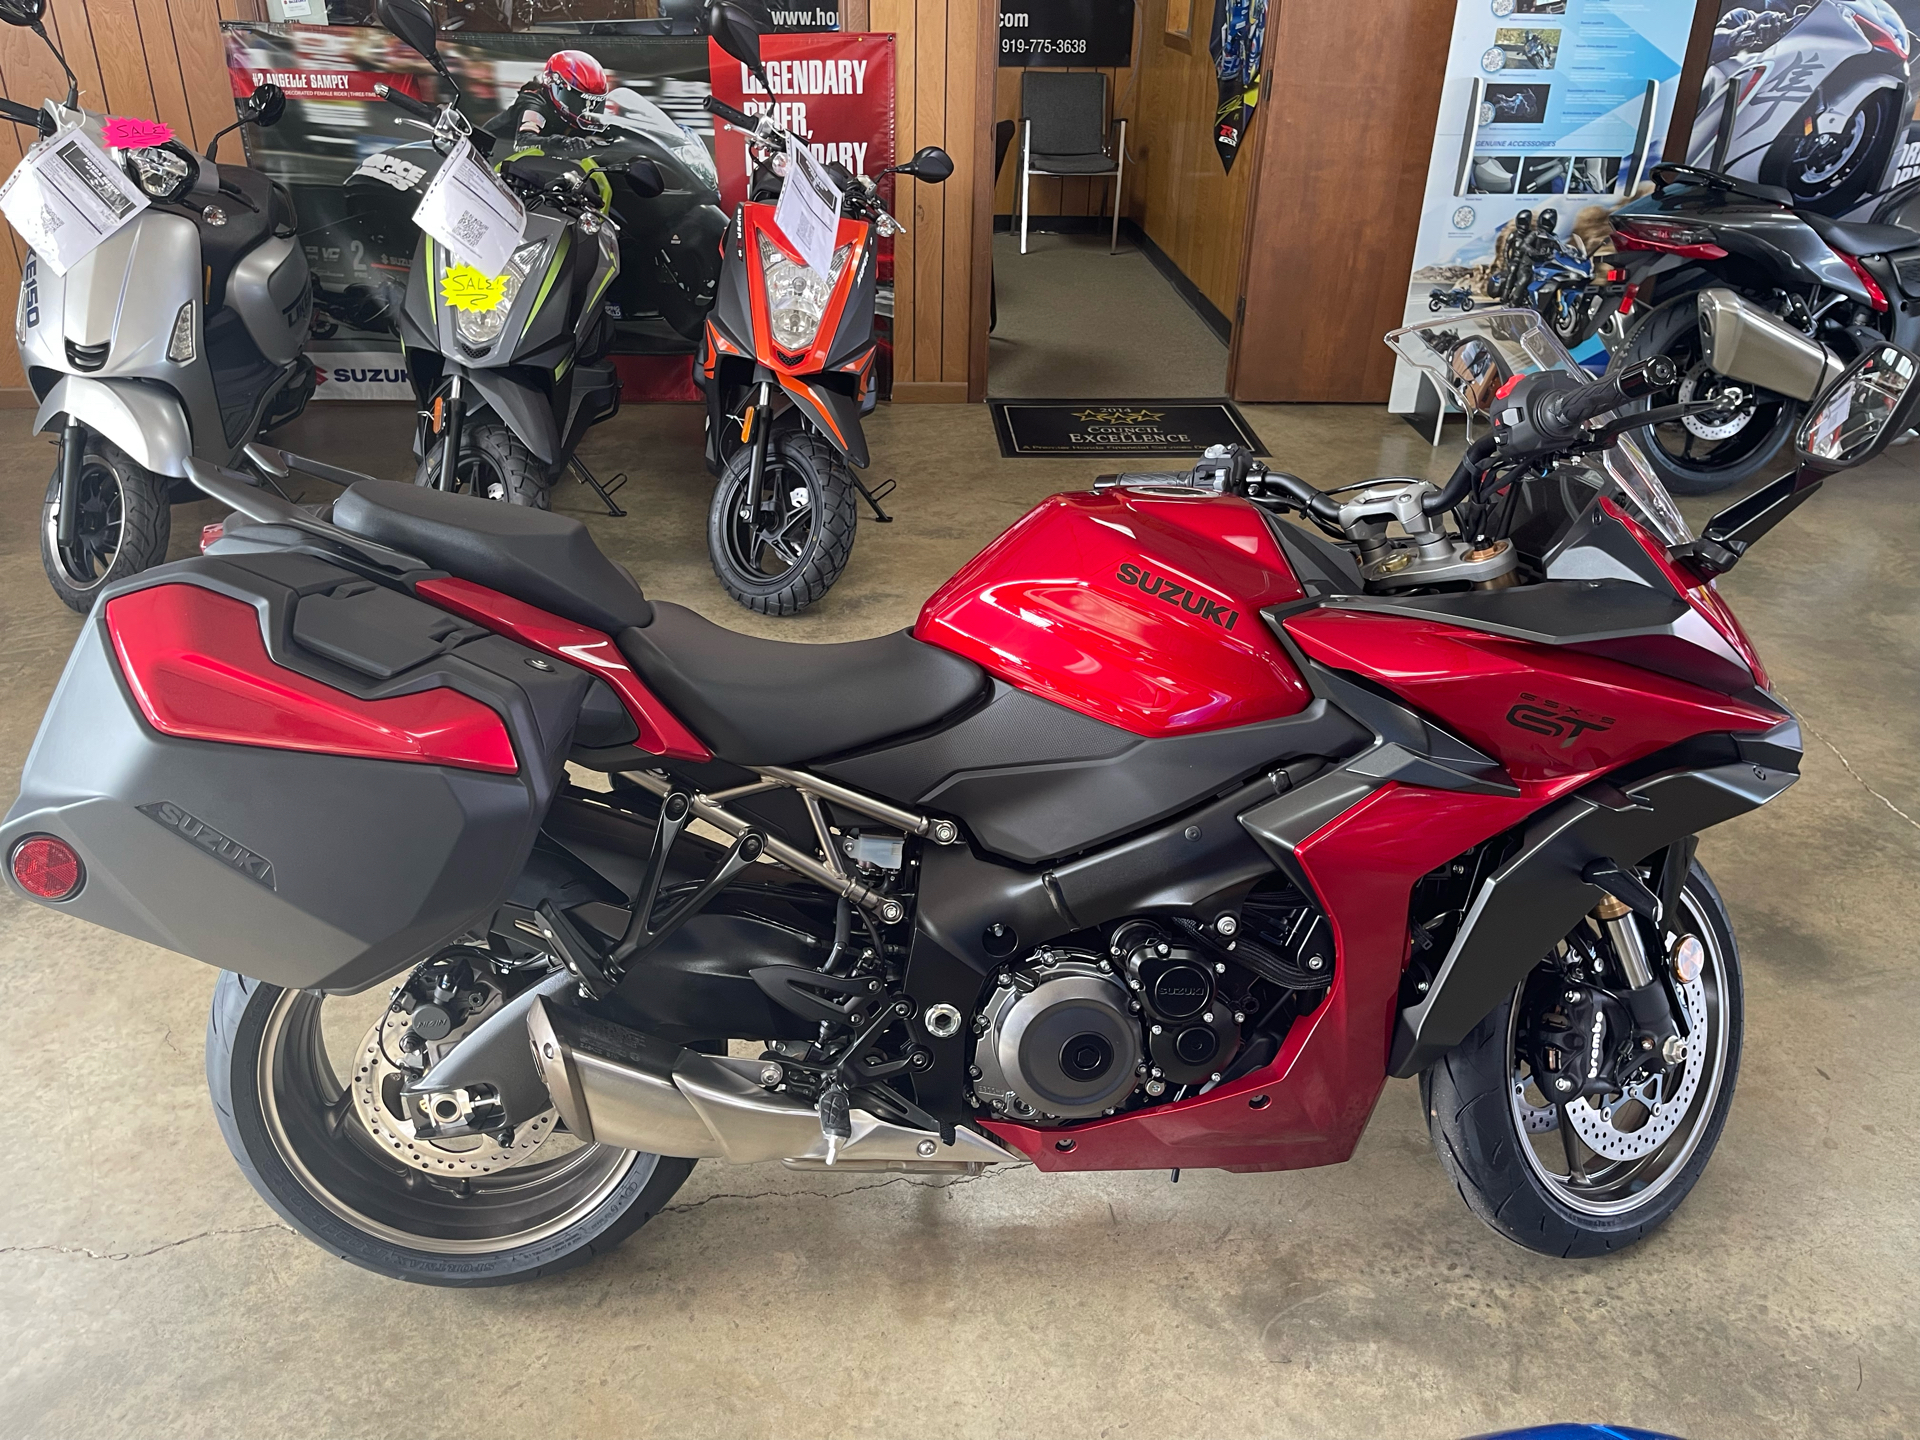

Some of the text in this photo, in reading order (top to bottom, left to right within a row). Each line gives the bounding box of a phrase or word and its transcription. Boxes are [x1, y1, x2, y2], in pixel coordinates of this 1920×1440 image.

[771, 8, 838, 26] www.ho
[1002, 39, 1087, 53] 919-775-3638
[266, 73, 308, 88] ANGELLE
[310, 74, 349, 89] SAMPEY
[1069, 433, 1191, 443] EXCELLENCE
[1116, 563, 1239, 631] SUZUKI
[158, 802, 272, 880] SUZUKI
[1160, 987, 1204, 996] SUZUKI
[1588, 1011, 1604, 1079] brembo
